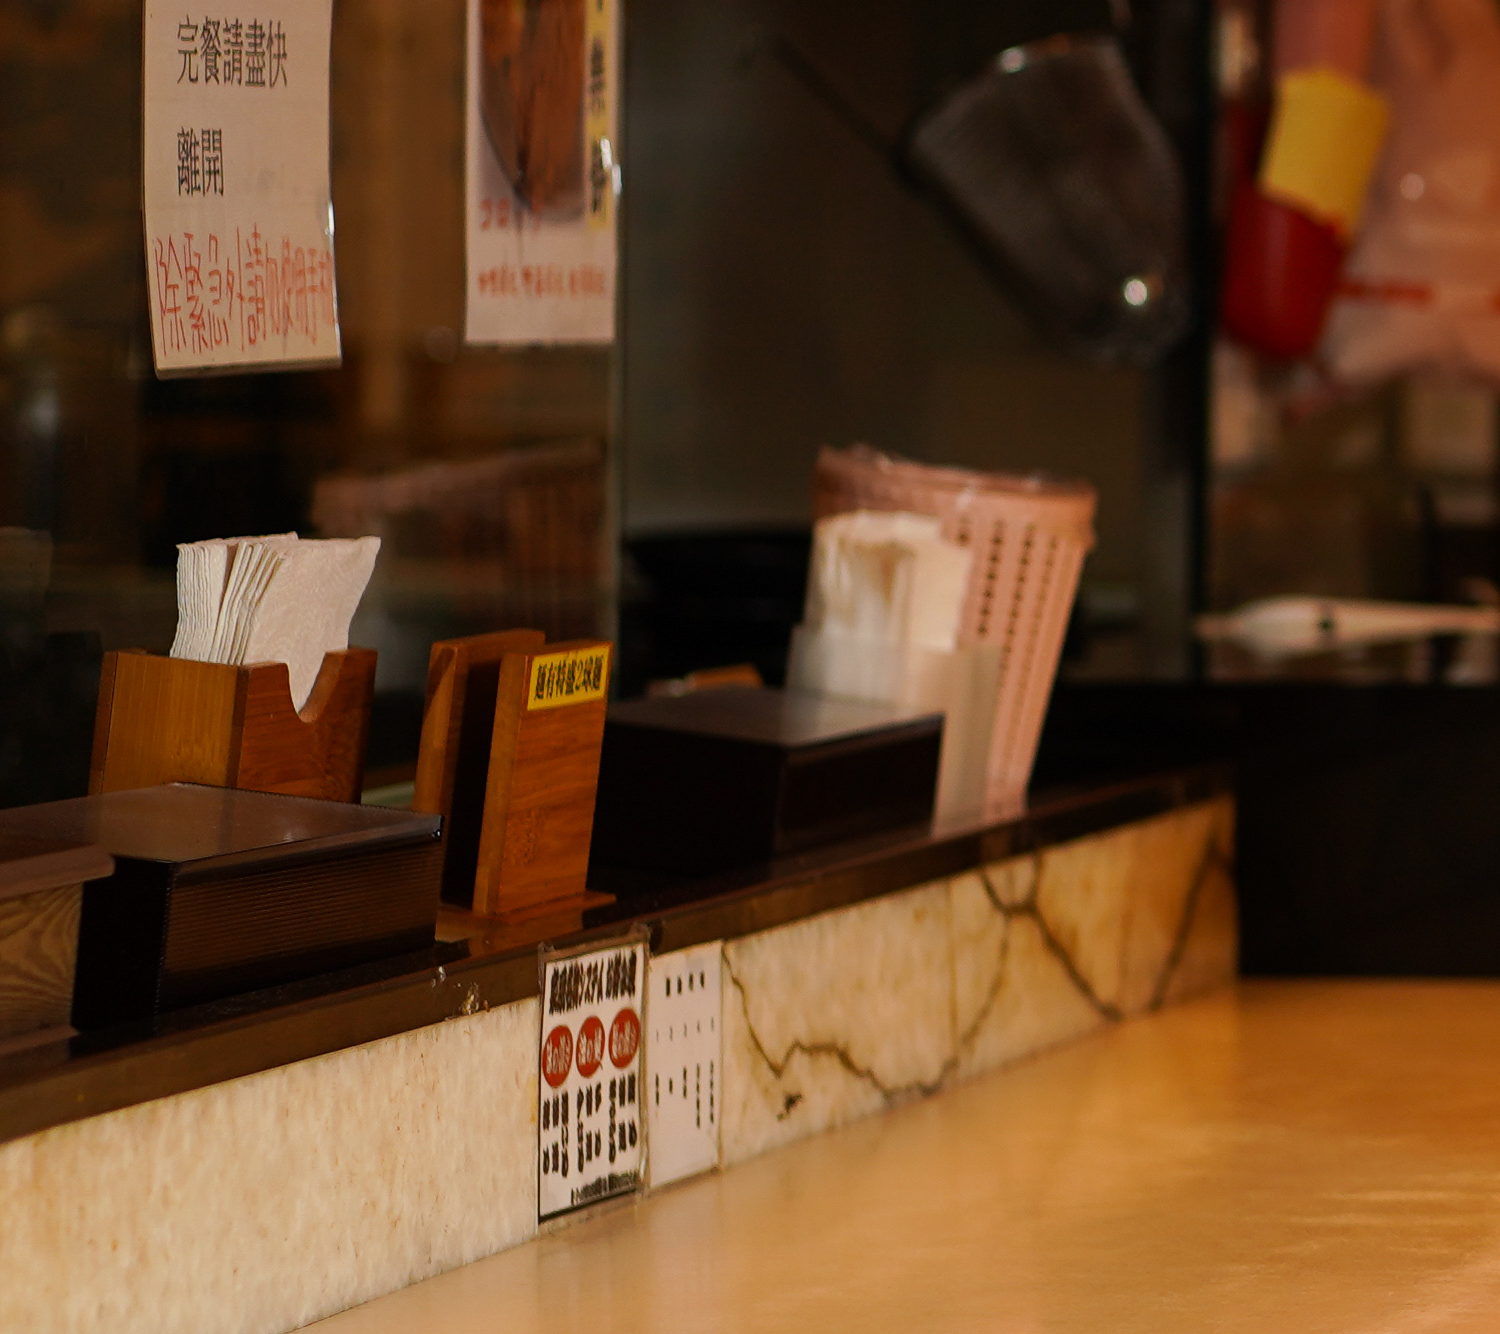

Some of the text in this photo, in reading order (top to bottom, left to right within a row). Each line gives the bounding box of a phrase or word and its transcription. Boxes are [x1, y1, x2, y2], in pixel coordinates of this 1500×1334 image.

[177, 14, 289, 88] 完餐請盡快
[177, 126, 225, 198] 離開
